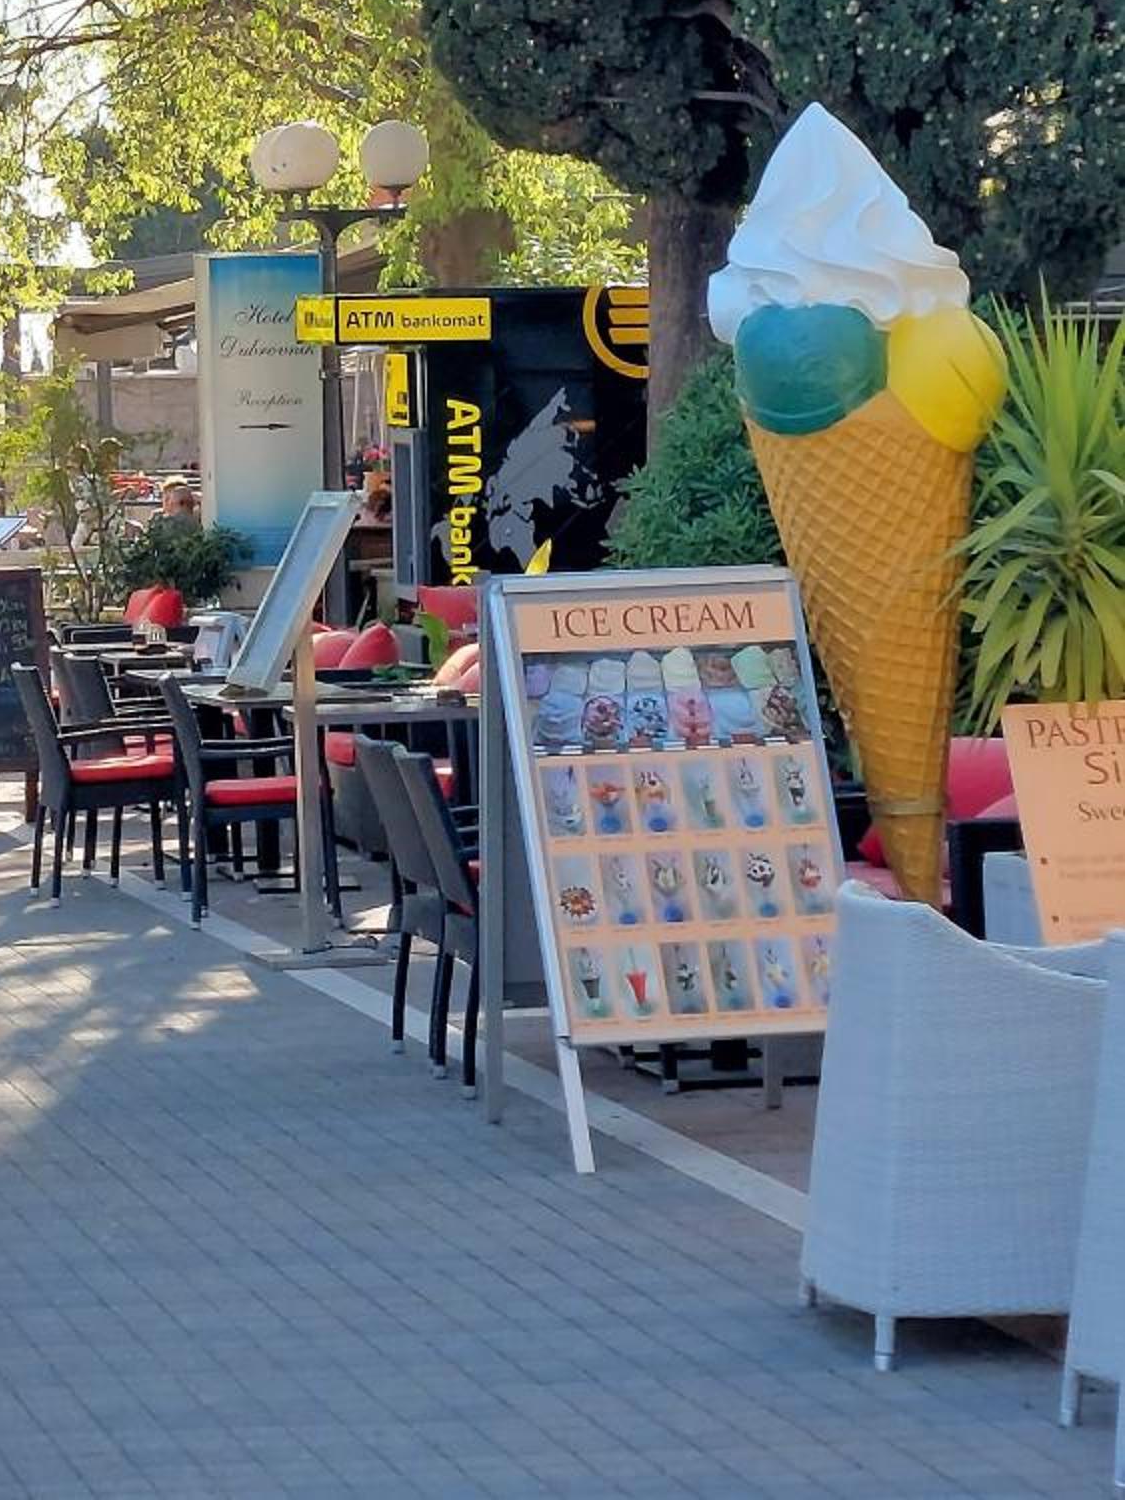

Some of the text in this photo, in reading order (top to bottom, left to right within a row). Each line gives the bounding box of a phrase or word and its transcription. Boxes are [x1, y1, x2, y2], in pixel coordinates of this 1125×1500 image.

[235, 301, 297, 324] Hotel
[346, 311, 394, 329] ATM
[402, 313, 485, 329] bankomat
[219, 336, 314, 358] Dubrovnik
[236, 390, 304, 412] Reception
[446, 398, 483, 495] ATM
[550, 601, 756, 639] ICE CREAM
[1084, 750, 1122, 786] Si
[1078, 801, 1125, 823] Swe
